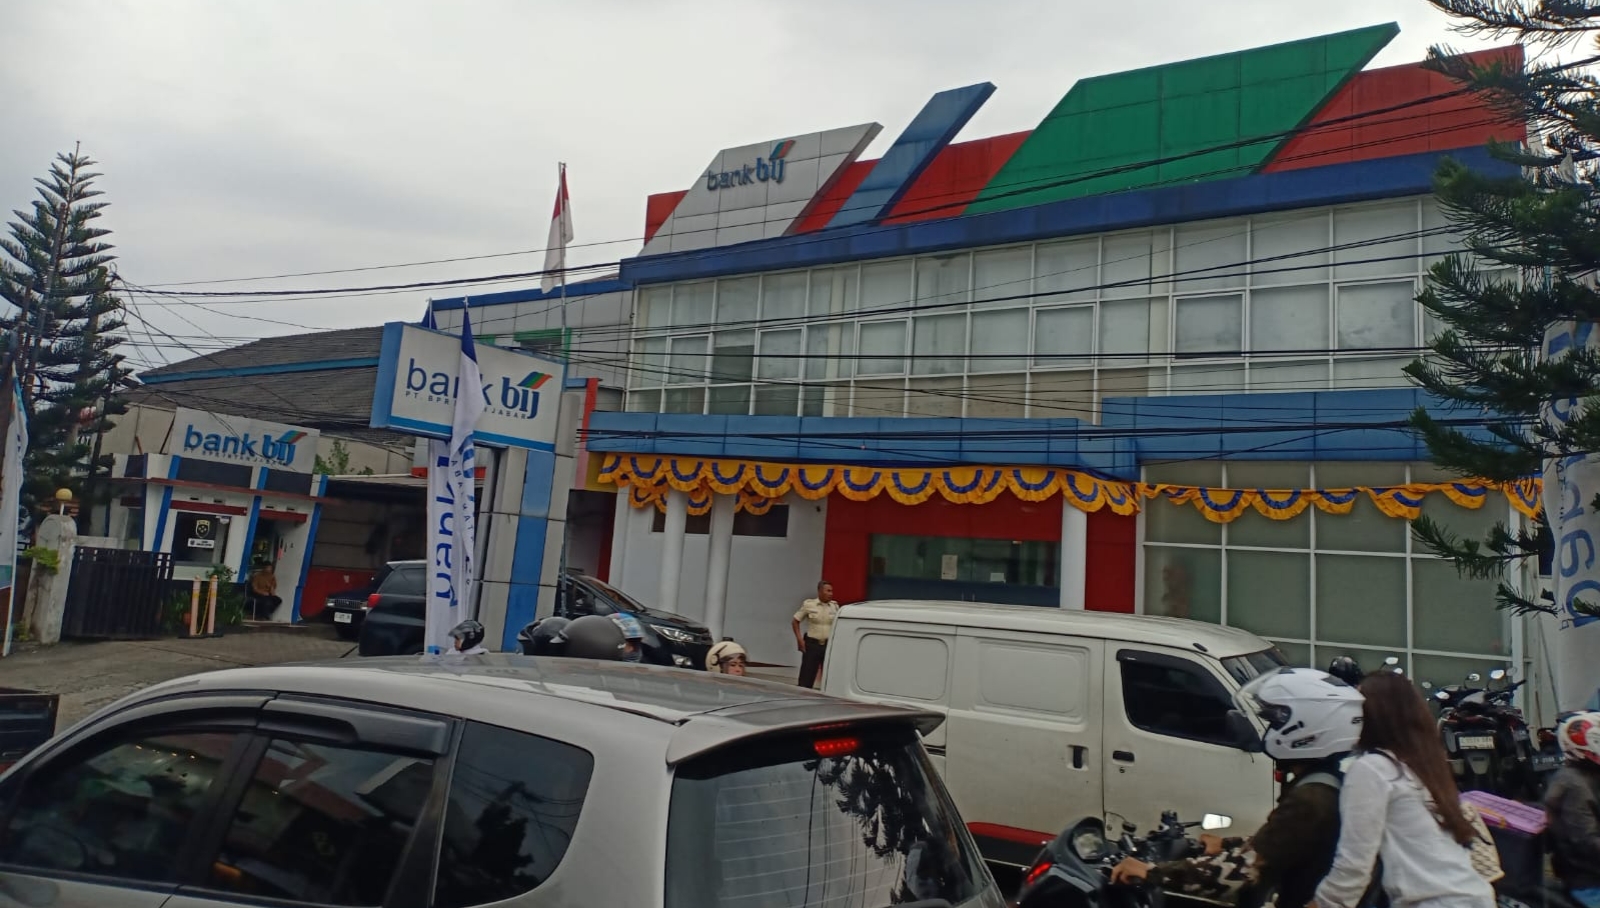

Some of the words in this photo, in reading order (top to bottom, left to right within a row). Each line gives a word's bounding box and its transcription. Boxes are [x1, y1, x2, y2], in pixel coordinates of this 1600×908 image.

[707, 163, 755, 191] bank
[406, 358, 493, 405] bak
[428, 395, 450, 405] BPR
[184, 424, 257, 457] bank
